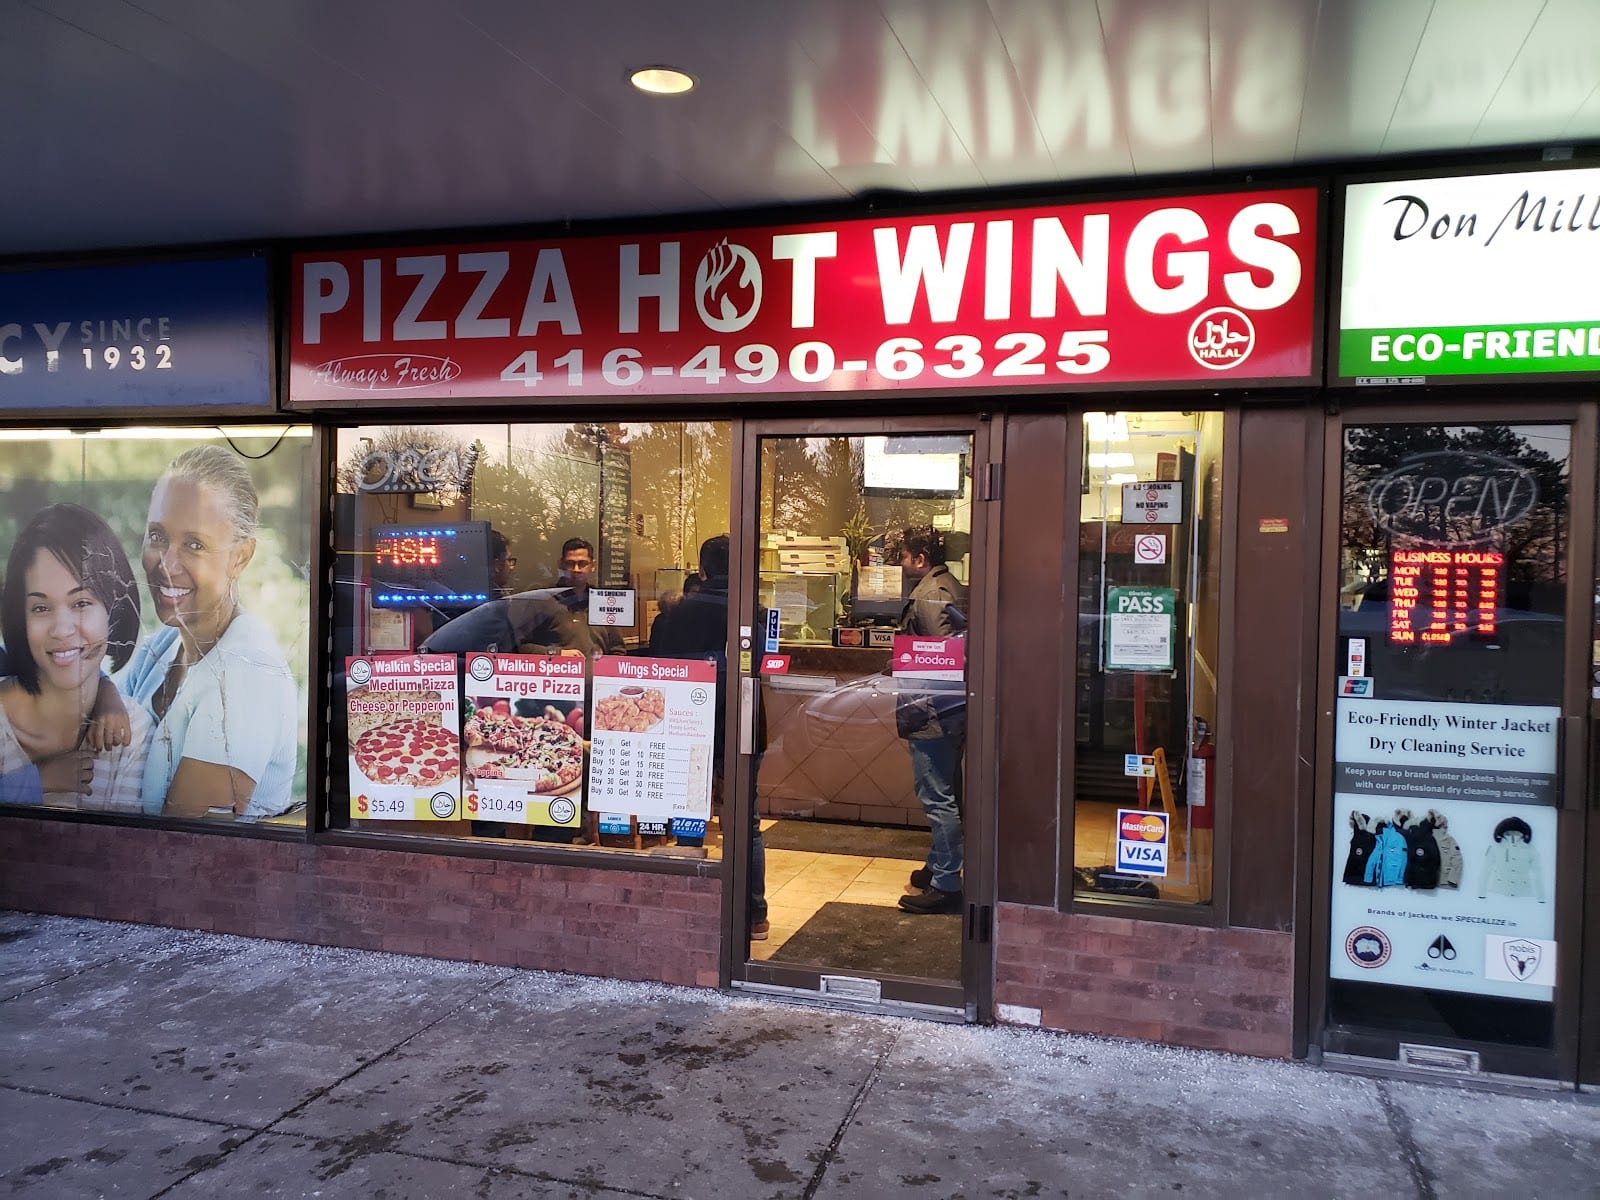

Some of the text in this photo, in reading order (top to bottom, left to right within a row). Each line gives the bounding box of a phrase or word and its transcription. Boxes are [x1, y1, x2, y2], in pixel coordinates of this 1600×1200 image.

[1383, 194, 1477, 241] Don
[302, 202, 1303, 345] PIZZA HOT WINGS
[80, 317, 171, 343] SINCE
[82, 344, 172, 371] 1932
[499, 329, 1112, 388] 416-490-6325
[1199, 348, 1242, 359] HALAL
[313, 355, 454, 389] Always Fresh
[1379, 477, 1520, 520] OPEN
[376, 537, 438, 564] FISH
[1393, 552, 1503, 564] BUSINESS HOURS
[1393, 567, 1420, 575] MON
[1393, 577, 1414, 586] TUE
[1393, 588, 1419, 597] WED
[1118, 596, 1164, 613] PASS
[1392, 599, 1416, 608] THU
[1392, 609, 1409, 618] FRI
[1392, 620, 1411, 629] SAT
[1391, 631, 1451, 641] SUN CLOSED
[374, 659, 455, 675] Walkin Special
[497, 658, 582, 675] Walkin Special
[914, 654, 956, 666] foodora
[618, 661, 688, 679] Wings Special
[369, 678, 455, 692] Medium Pizza
[495, 677, 581, 696] Large Pizza
[350, 699, 455, 714] Cheese or Pepperoni
[1348, 711, 1551, 733] Eco-Friendly Winter Jacket
[593, 737, 666, 750] Buy Get FREE
[1369, 736, 1526, 758] Dry Cleaning Service
[592, 747, 604, 756] Buy
[609, 748, 616, 756] 10
[620, 749, 631, 757] Get
[649, 752, 665, 760] FREE
[592, 757, 603, 766] Buy
[608, 758, 615, 766] 15
[619, 759, 630, 767] Get
[648, 761, 665, 769] FREE
[591, 767, 603, 776] Buy
[619, 769, 630, 777] Get
[636, 770, 643, 778] 20
[648, 771, 664, 780] FREE
[1345, 767, 1365, 777] Keep
[1366, 768, 1386, 779] your
[1388, 769, 1402, 779] top
[1404, 769, 1430, 779] brand
[1431, 771, 1460, 781] winter
[1462, 773, 1494, 784] jackets
[1496, 775, 1529, 786] looking
[591, 776, 602, 785] Buy
[618, 778, 629, 786] Get
[635, 780, 643, 788] 30
[647, 781, 664, 789] FREE
[1355, 780, 1538, 799] with our professional dry cleaning service.
[591, 786, 664, 799] Buy 50 Get 50 FREE
[357, 793, 405, 813] $ $5.49
[467, 793, 523, 814] $ $10.49
[639, 822, 651, 831] 24
[651, 822, 667, 831] HR.
[1121, 820, 1165, 833] MasterCard
[1124, 845, 1163, 862] VISA
[1367, 908, 1396, 917] Brands
[1408, 911, 1438, 921] jackets
[1455, 915, 1507, 927] SPECIALIZE
[1509, 944, 1536, 954] nobis
